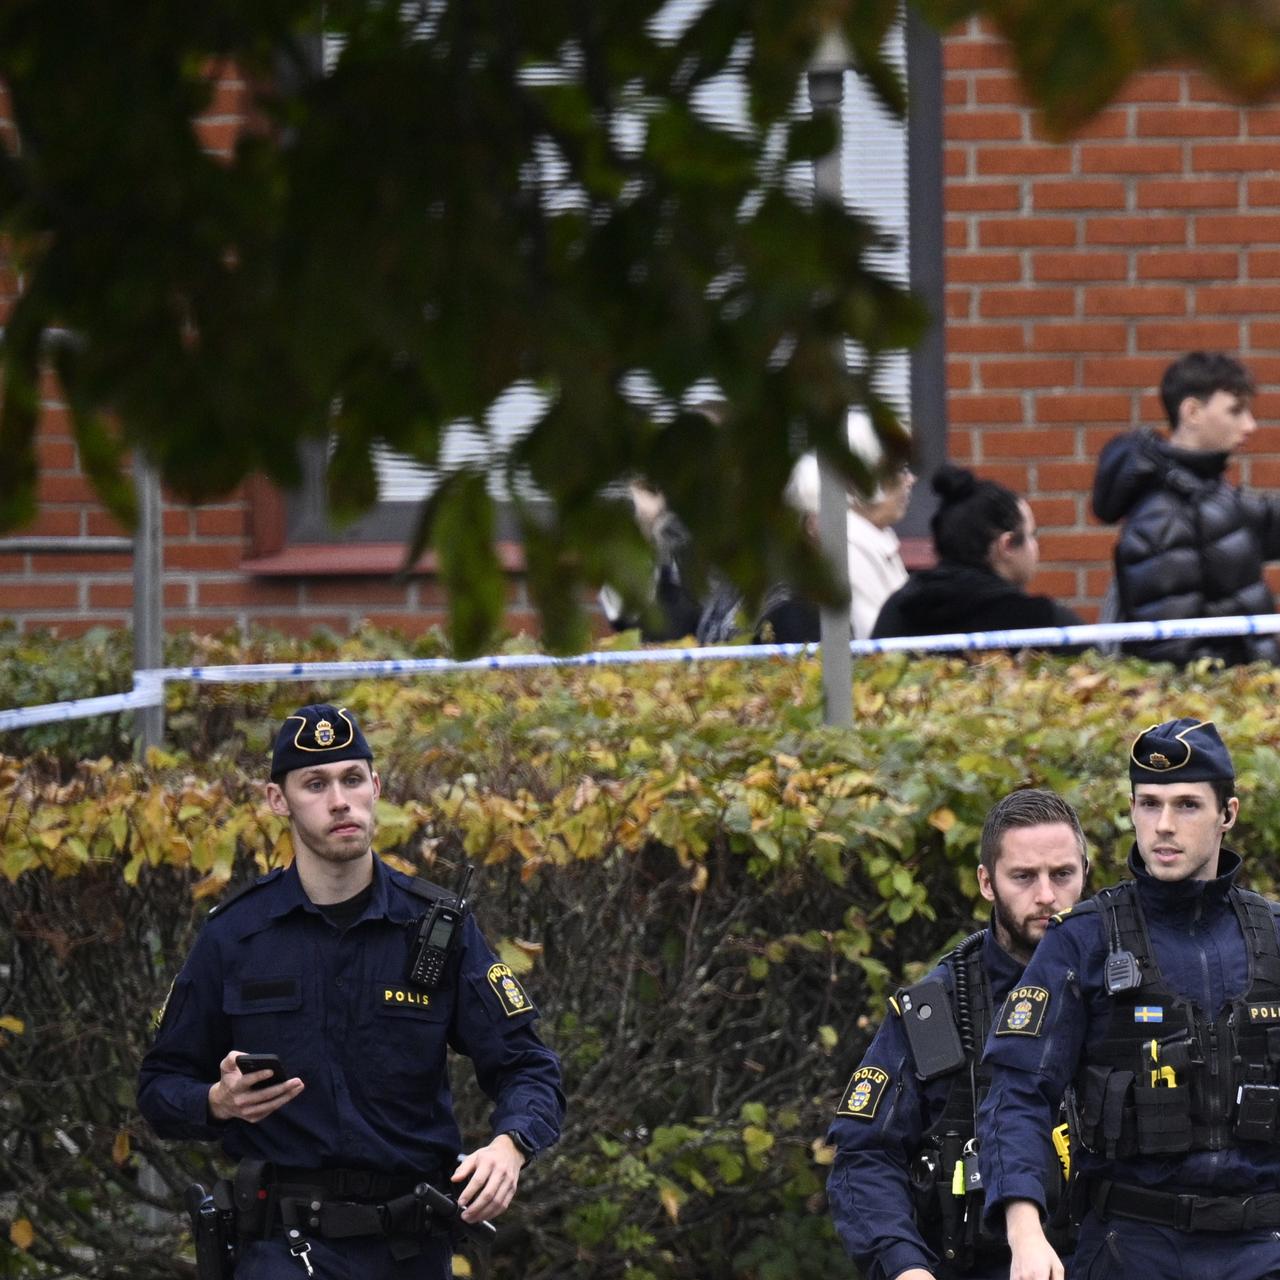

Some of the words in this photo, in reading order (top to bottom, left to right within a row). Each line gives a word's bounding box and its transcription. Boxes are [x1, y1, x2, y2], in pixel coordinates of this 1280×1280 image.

[384, 990, 430, 1006] POLIS
[1011, 986, 1046, 1002] POLIS
[854, 1069, 885, 1084] POLIS
